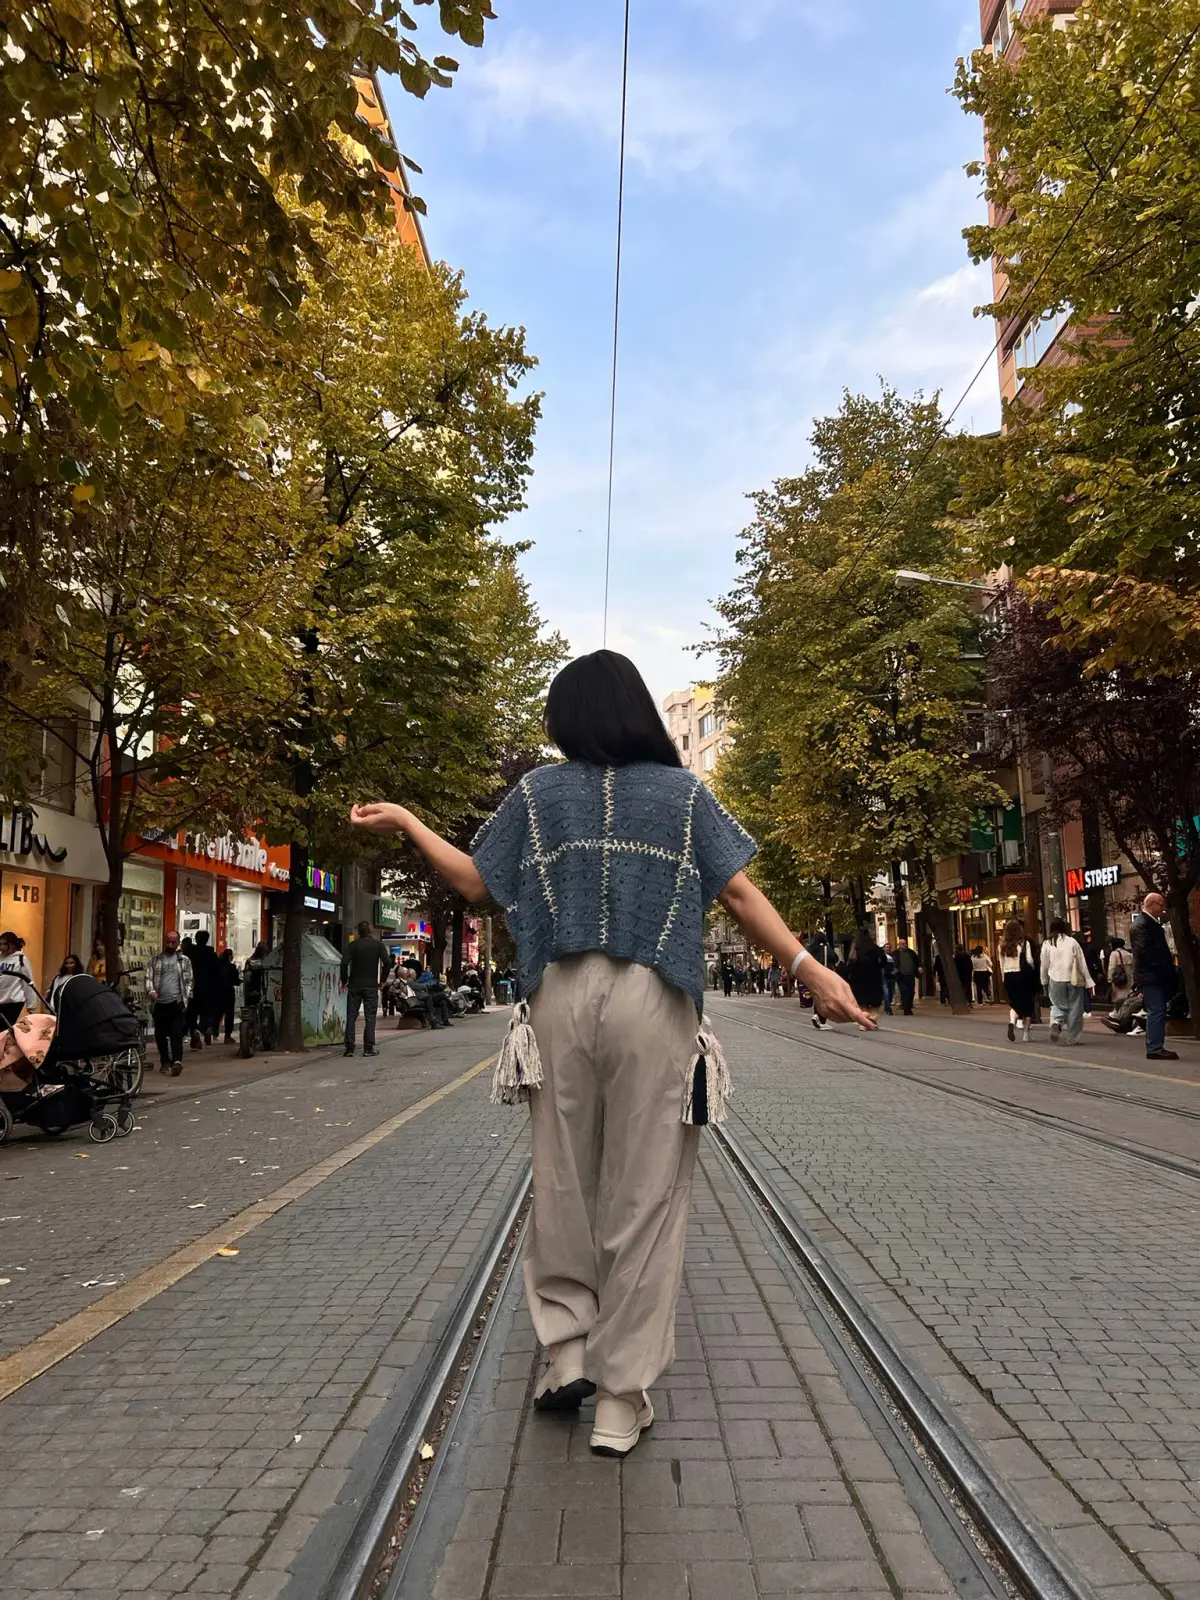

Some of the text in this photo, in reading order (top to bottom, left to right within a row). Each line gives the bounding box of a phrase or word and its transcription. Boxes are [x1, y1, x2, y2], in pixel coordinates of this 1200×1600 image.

[1067, 865, 1119, 895] IN STREET
[13, 883, 39, 903] LTB
